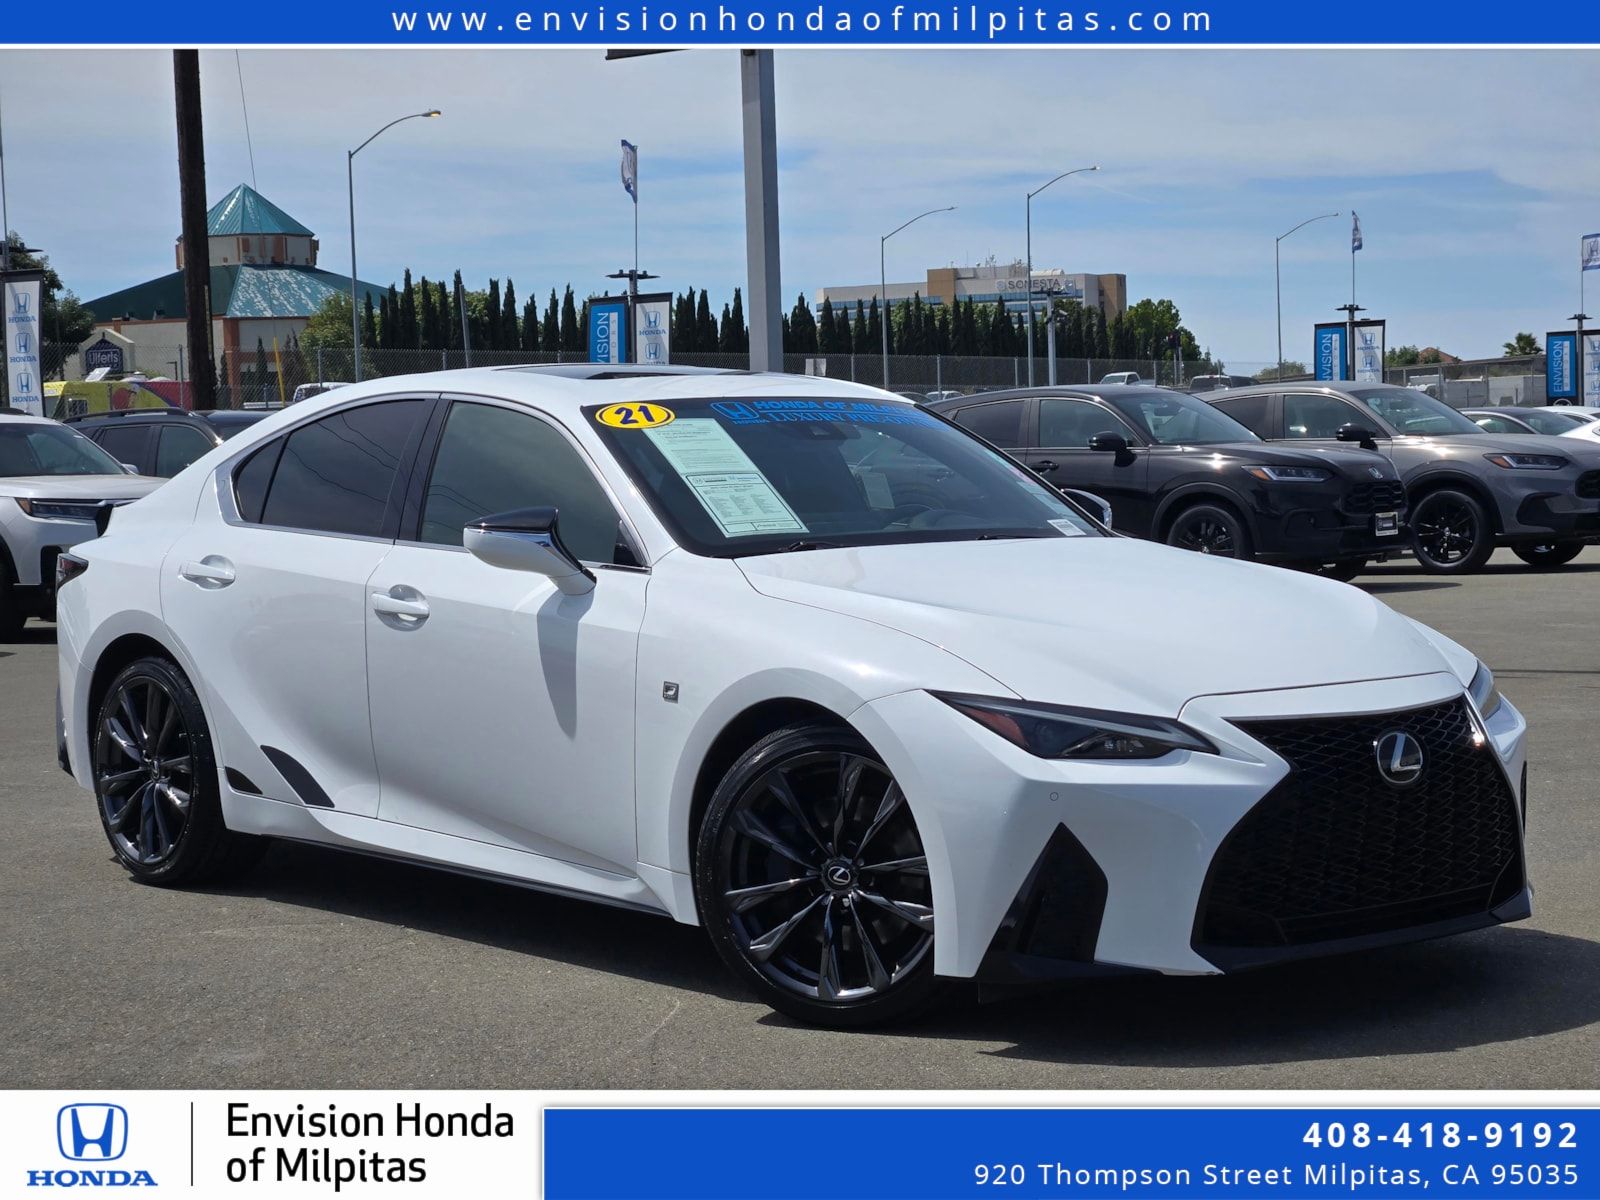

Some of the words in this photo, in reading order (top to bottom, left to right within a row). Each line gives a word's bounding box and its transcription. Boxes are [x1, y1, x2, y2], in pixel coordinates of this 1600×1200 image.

[8, 316, 37, 324] HONDA
[640, 328, 667, 336] HONDA
[9, 355, 37, 363] HONDA
[1553, 341, 1563, 392] ENVISION
[12, 395, 39, 403] HONDA
[752, 400, 821, 410] HONDA
[823, 400, 846, 410] OF
[614, 405, 656, 425] 21
